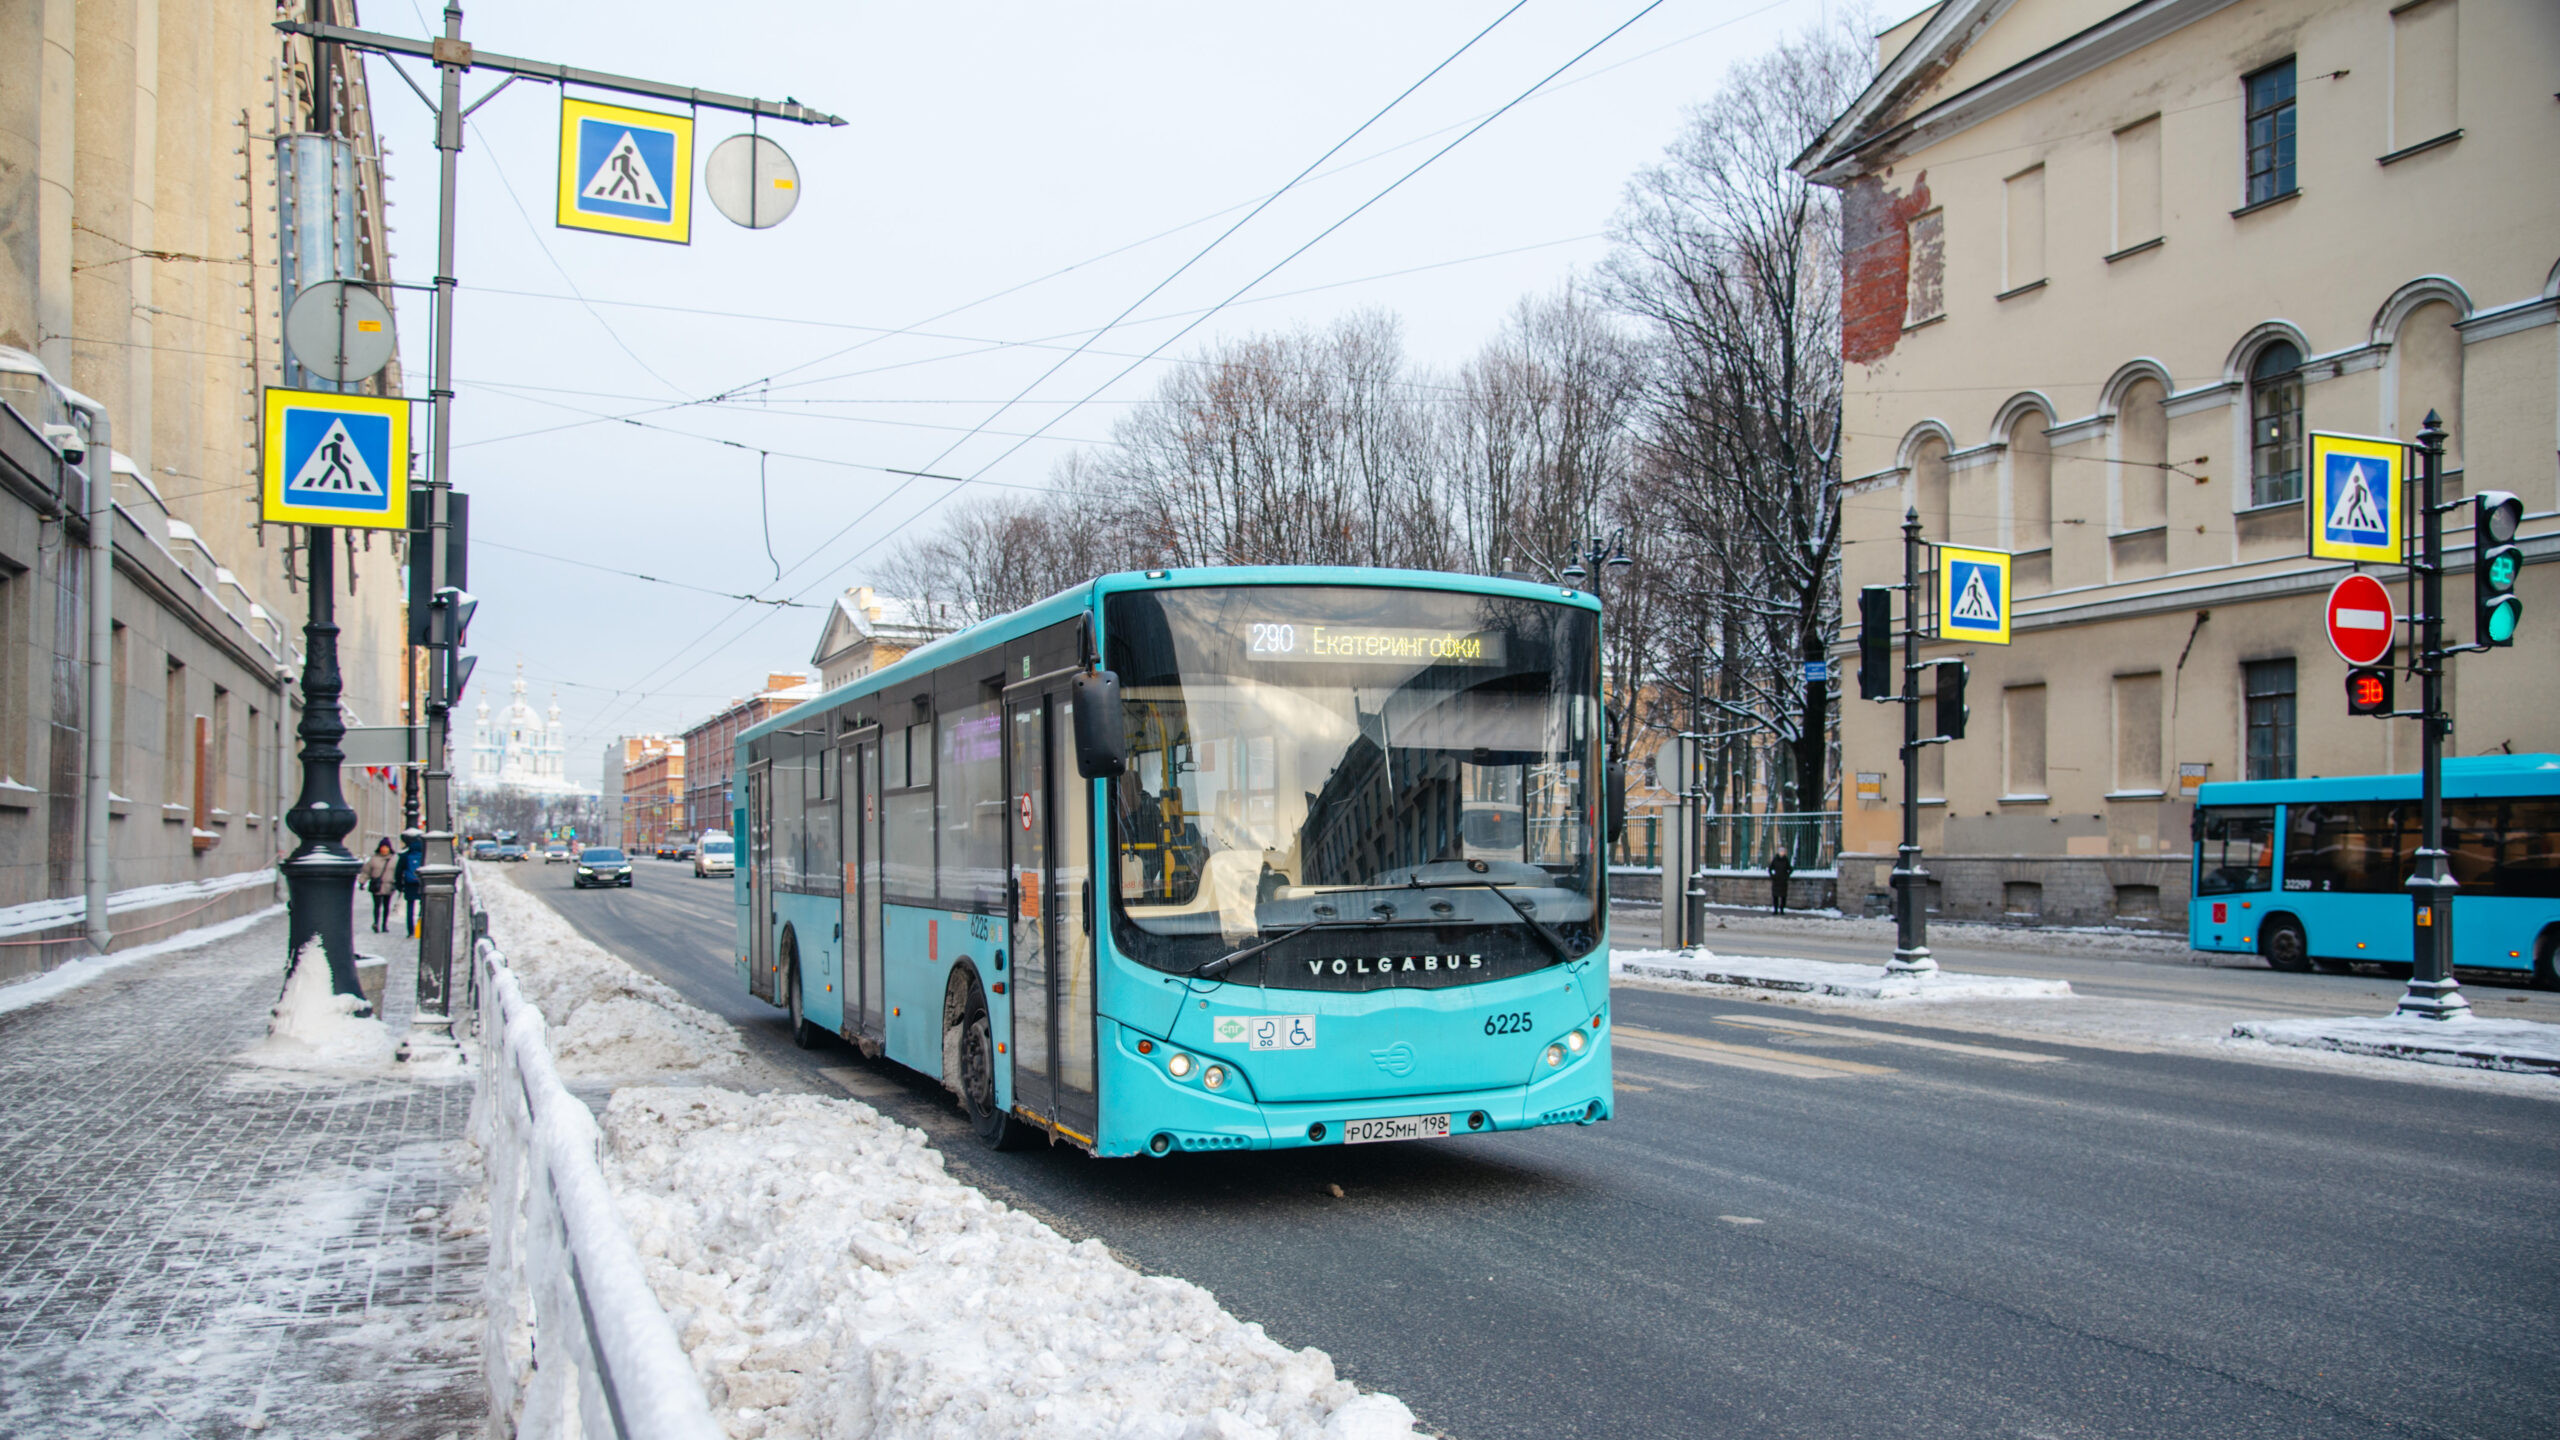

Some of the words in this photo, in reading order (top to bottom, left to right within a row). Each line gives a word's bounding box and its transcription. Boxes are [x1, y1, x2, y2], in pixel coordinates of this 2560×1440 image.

[1252, 622, 1294, 653] 290
[2356, 677, 2384, 704] 38
[971, 913, 989, 942] 6225
[1309, 954, 1482, 975] VOLGABUS
[1484, 1012, 1533, 1036] 6225
[1421, 1116, 1446, 1131] 198
